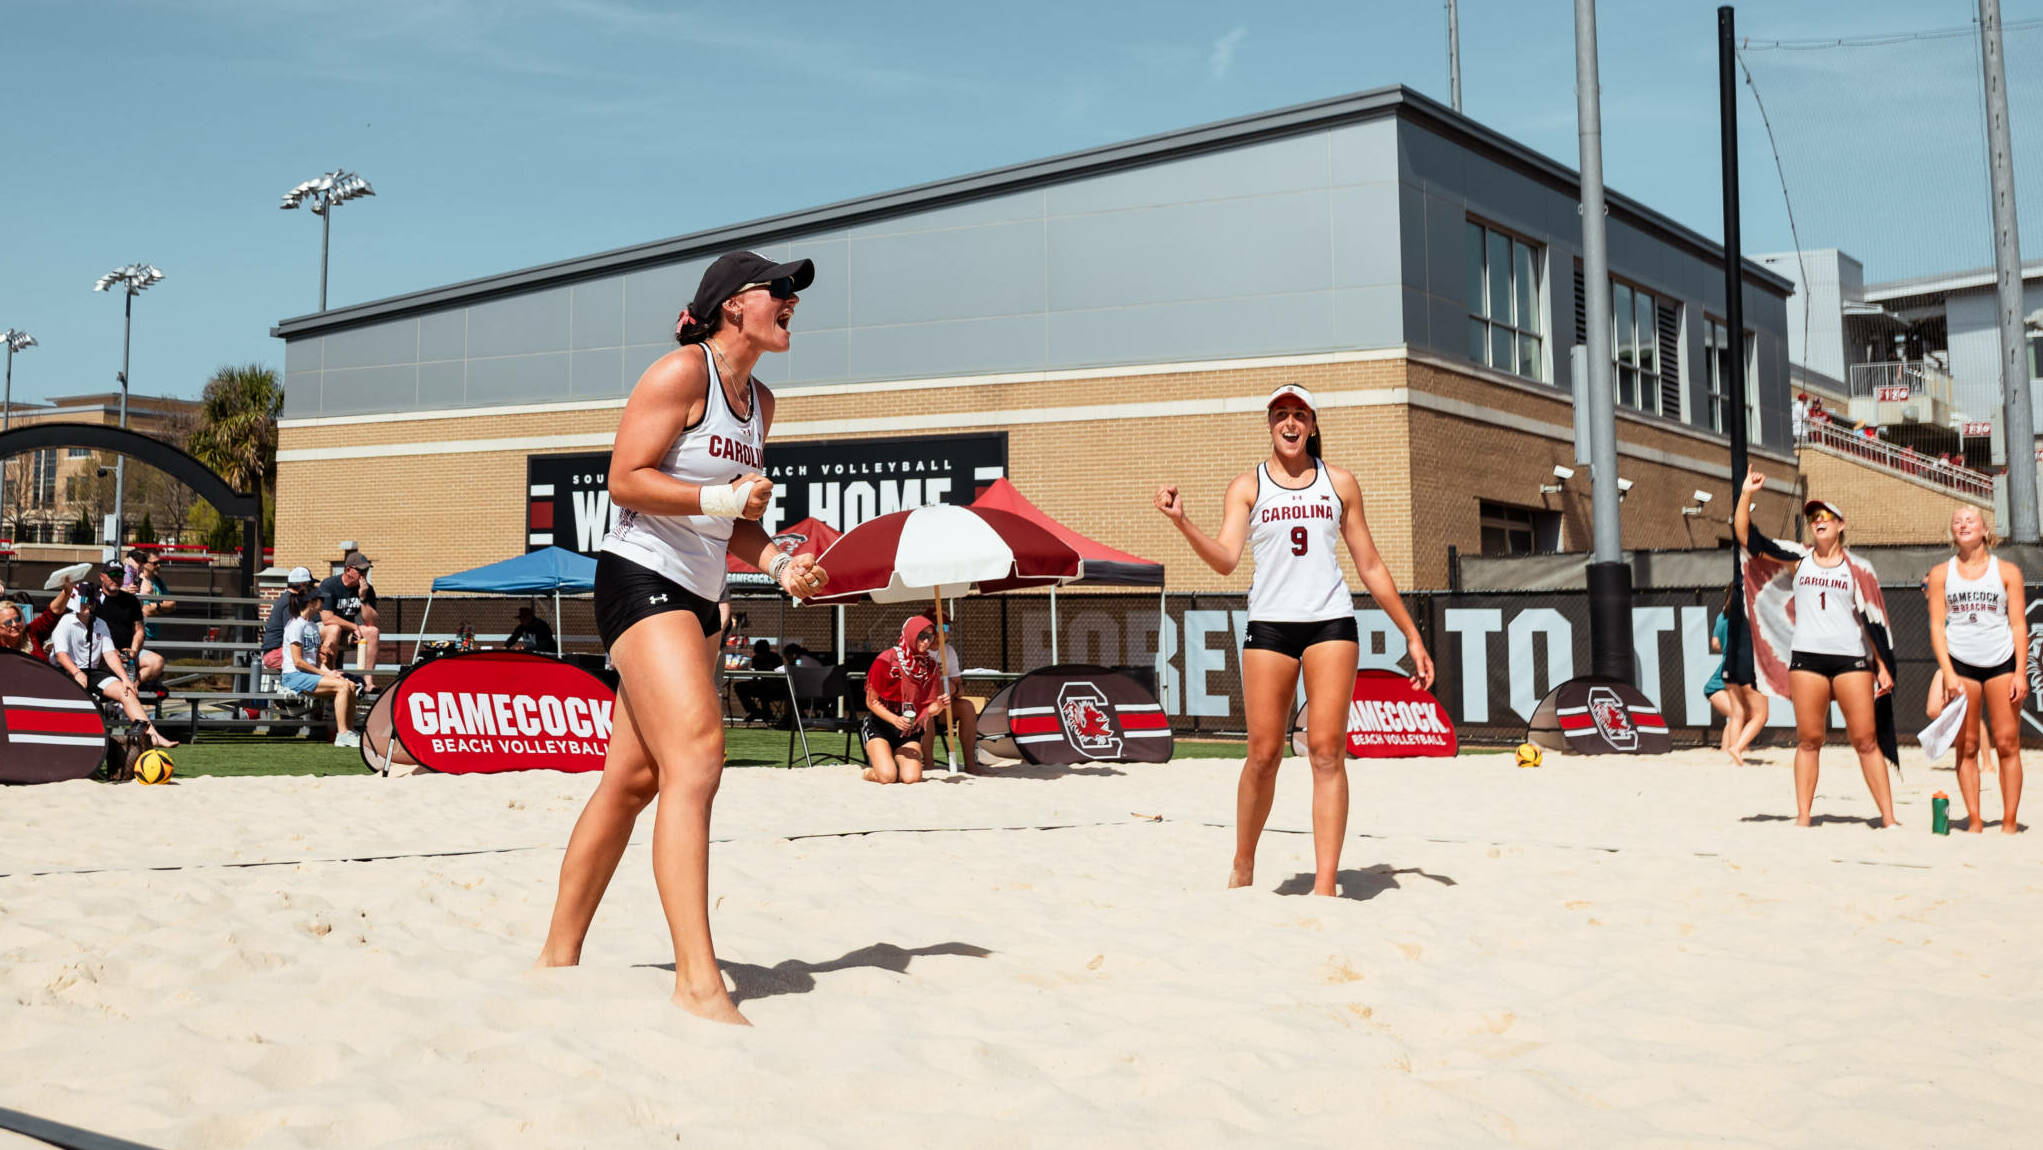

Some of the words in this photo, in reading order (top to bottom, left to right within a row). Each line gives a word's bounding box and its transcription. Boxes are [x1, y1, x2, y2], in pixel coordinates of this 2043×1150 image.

[708, 434, 764, 471] CAROLIN
[572, 474, 604, 485] SOU
[821, 459, 952, 475] VOLLEYBALL
[1261, 503, 1334, 523] CAROLINA
[1290, 525, 1308, 557] 9
[1799, 576, 1849, 591] CAROLINA
[1818, 591, 1827, 611] 1
[1946, 591, 1999, 604] GAMECOCK
[1960, 602, 1986, 613] BEACH
[1444, 607, 1574, 723] TO
[407, 691, 614, 739] GAMECOCK
[1346, 699, 1448, 733] AMECOCK
[431, 738, 495, 754] BEACH
[497, 739, 609, 756] VOLLEYBAL
[1351, 733, 1385, 746] BEACH
[1383, 733, 1447, 746] VOLLEYBALL
